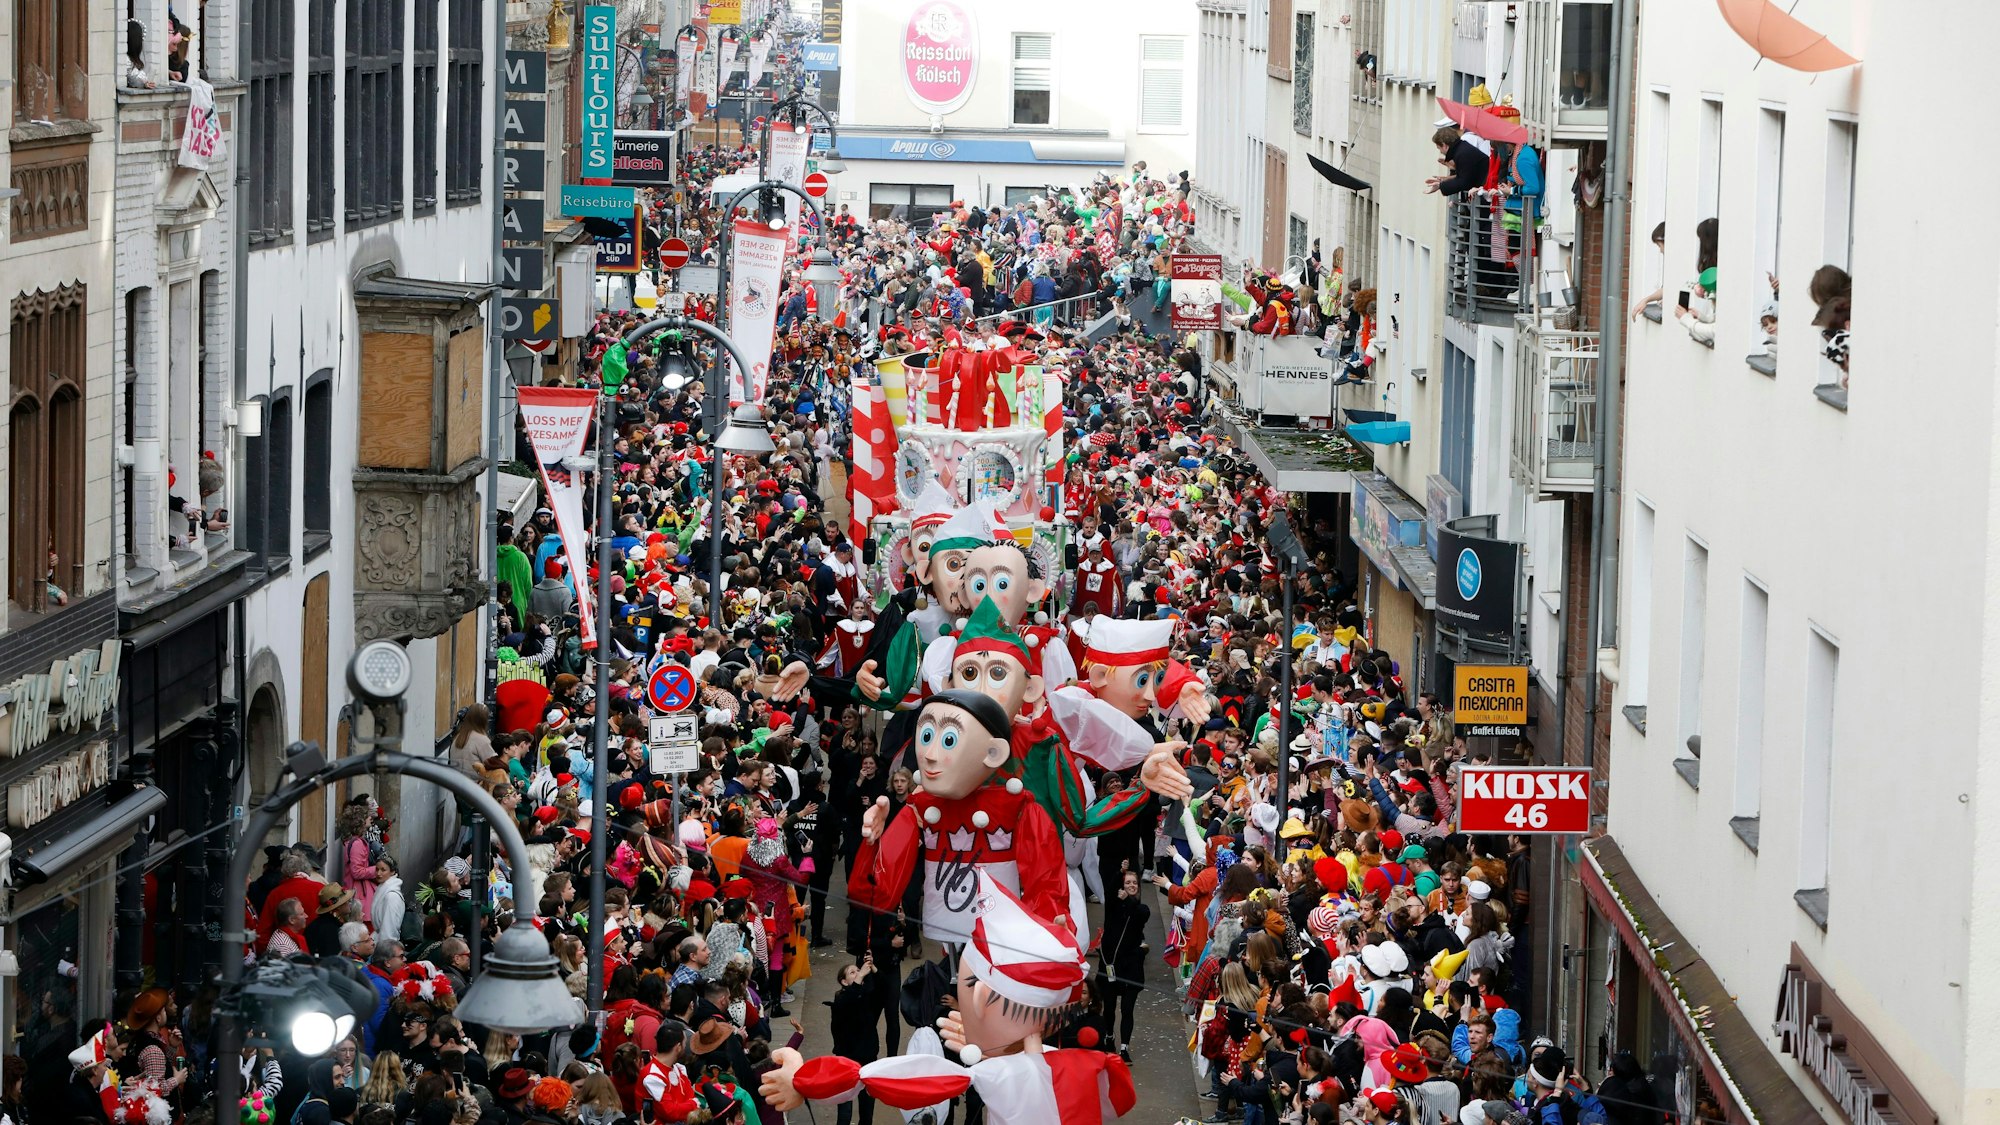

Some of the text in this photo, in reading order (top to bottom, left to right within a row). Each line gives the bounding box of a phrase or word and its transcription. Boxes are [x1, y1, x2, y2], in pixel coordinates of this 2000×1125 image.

[806, 50, 836, 61] APOLLO
[916, 64, 961, 86] Kölsch
[588, 15, 610, 168] suntours
[613, 140, 660, 152] fümerie
[889, 140, 929, 154] APOLLO
[612, 156, 664, 170] allach
[502, 58, 528, 332] MARANO
[563, 194, 633, 209] Reisebüro
[595, 242, 632, 255] ALDI
[605, 254, 620, 263] SÜD
[1265, 370, 1328, 380] HENNES
[527, 415, 556, 426] LOSS
[1468, 677, 1515, 693] CASITA
[1459, 696, 1523, 712] MEXICANA
[1472, 725, 1520, 737] Gaffel Kölsch
[1464, 773, 1587, 800] KIOSK
[1504, 803, 1548, 829] 46
[793, 822, 817, 830] SWAT
